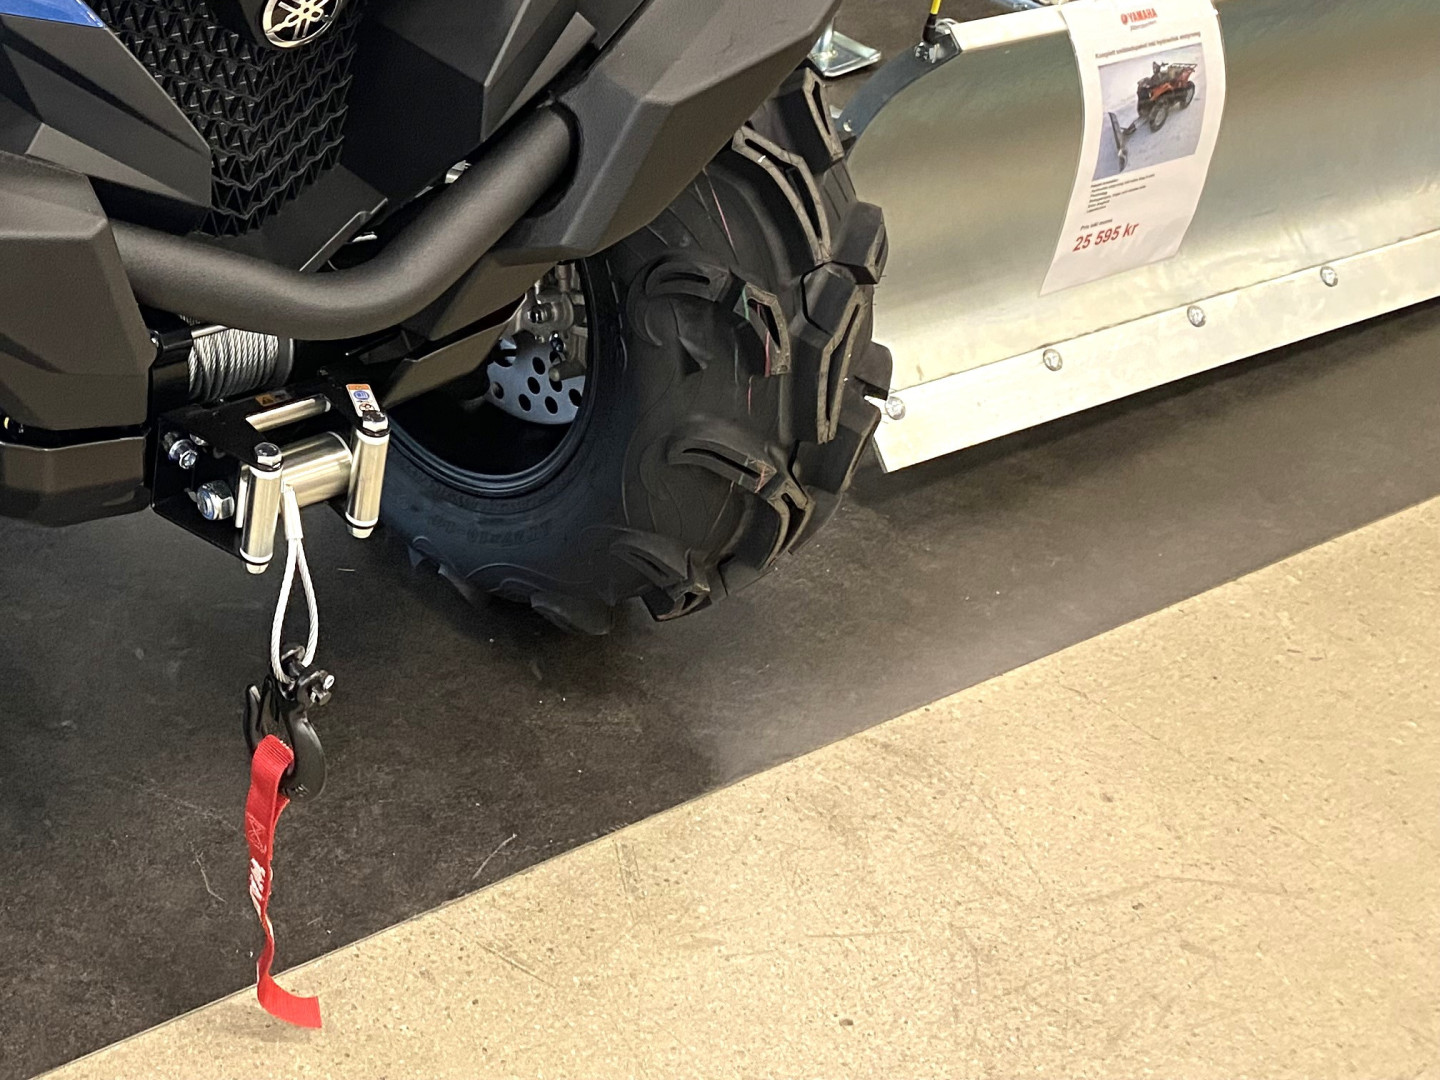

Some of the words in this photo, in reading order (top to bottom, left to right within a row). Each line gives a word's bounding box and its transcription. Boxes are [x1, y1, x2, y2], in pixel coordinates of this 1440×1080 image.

[1128, 8, 1158, 22] YAMAHA
[1072, 234, 1092, 252] 25
[1094, 225, 1122, 246] 595
[1122, 223, 1139, 238] kr
